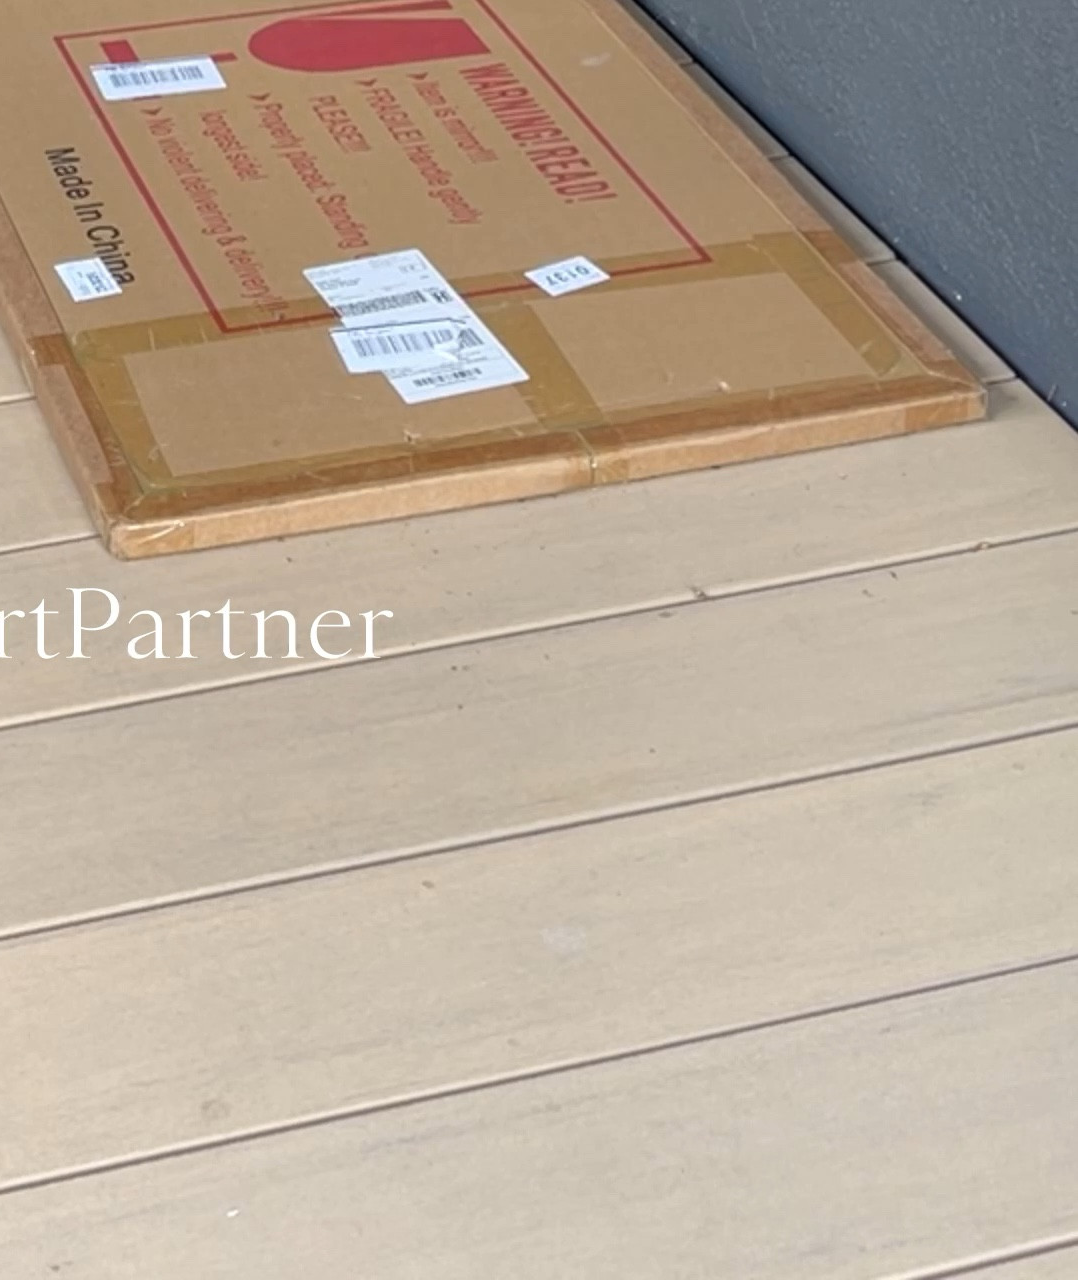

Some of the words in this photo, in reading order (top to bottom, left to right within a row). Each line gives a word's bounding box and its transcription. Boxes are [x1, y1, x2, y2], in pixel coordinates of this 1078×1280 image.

[145, 117, 175, 137] No
[198, 108, 248, 154] longest
[224, 152, 270, 182] side!
[361, 87, 430, 151] FRAGILE!
[458, 62, 570, 148] WARNING!
[525, 145, 619, 204] READ!
[44, 146, 94, 200] Made
[158, 136, 203, 177] violent
[253, 102, 305, 150] Properly
[315, 193, 369, 250] Standing
[405, 148, 453, 186] Handle
[73, 201, 104, 223] In
[180, 175, 233, 236] delivering
[427, 187, 484, 225] gently
[85, 224, 136, 286] China
